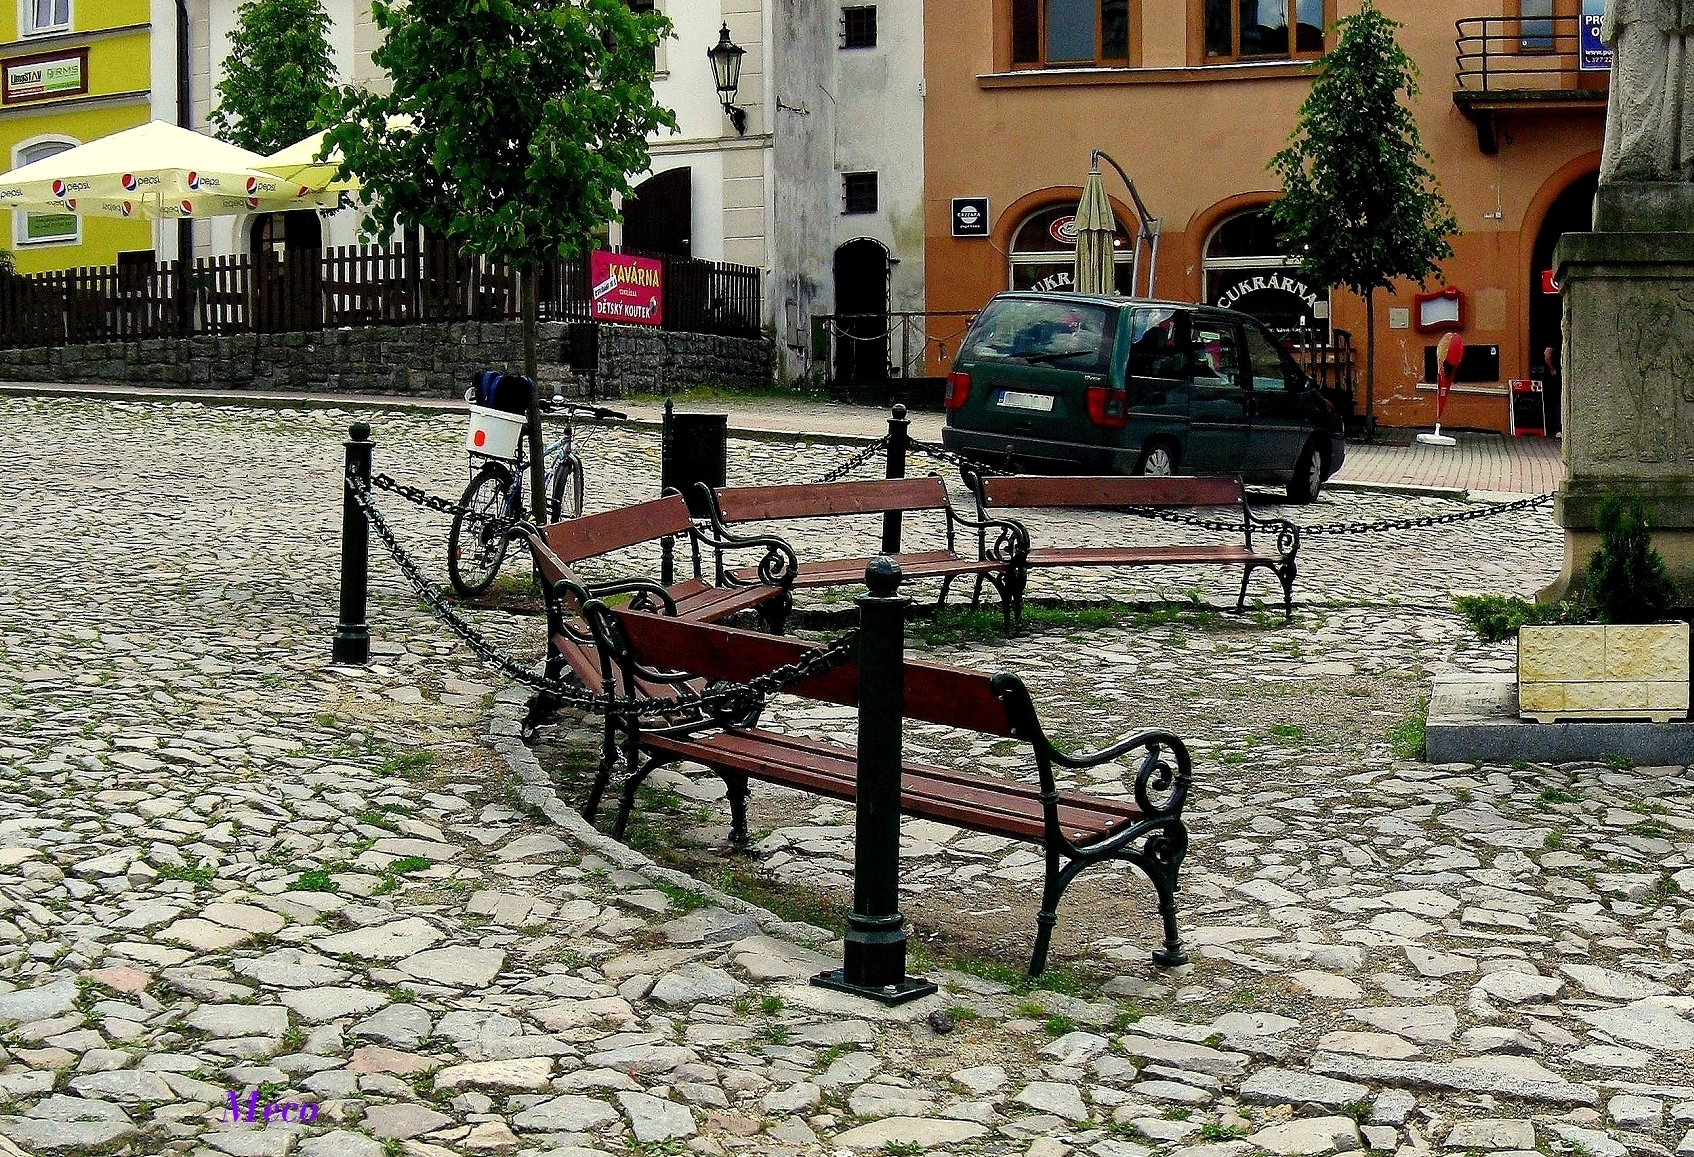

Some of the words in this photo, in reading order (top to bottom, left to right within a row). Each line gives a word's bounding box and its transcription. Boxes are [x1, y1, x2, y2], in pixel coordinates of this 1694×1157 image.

[67, 180, 91, 191] pepsi
[137, 176, 161, 186] pepsi
[200, 177, 220, 186] pepsi
[258, 182, 276, 192] pepsi
[0, 187, 23, 199] pepsi
[609, 261, 659, 287] KAVÁRNA
[1217, 271, 1317, 309] CUKRÁRNA
[597, 297, 624, 315] DĚTSKÝ
[624, 304, 651, 319] KOUTEK
